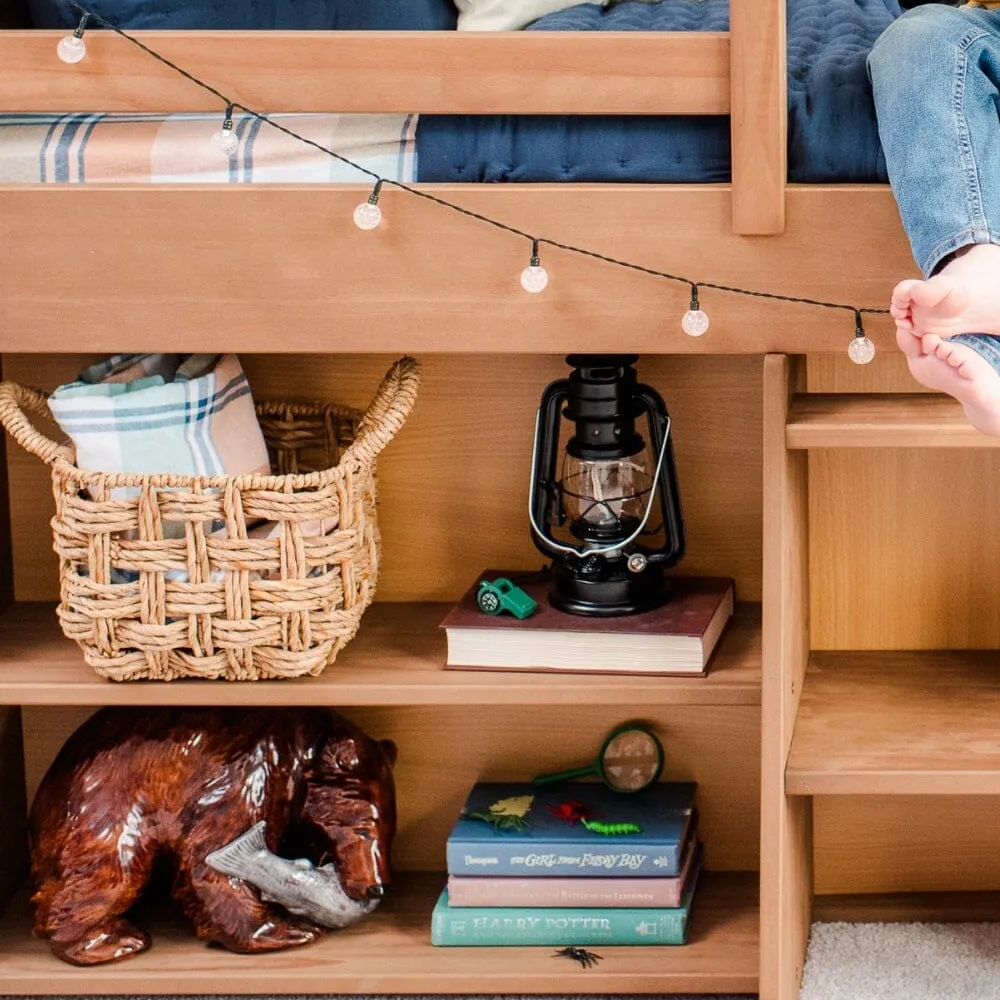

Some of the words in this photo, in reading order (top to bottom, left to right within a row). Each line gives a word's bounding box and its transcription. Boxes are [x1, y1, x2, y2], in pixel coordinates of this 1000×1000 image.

[525, 853, 560, 867] GIRL
[616, 853, 647, 870] BAY
[473, 916, 541, 929] HARRY
[545, 917, 612, 930] POTTER
